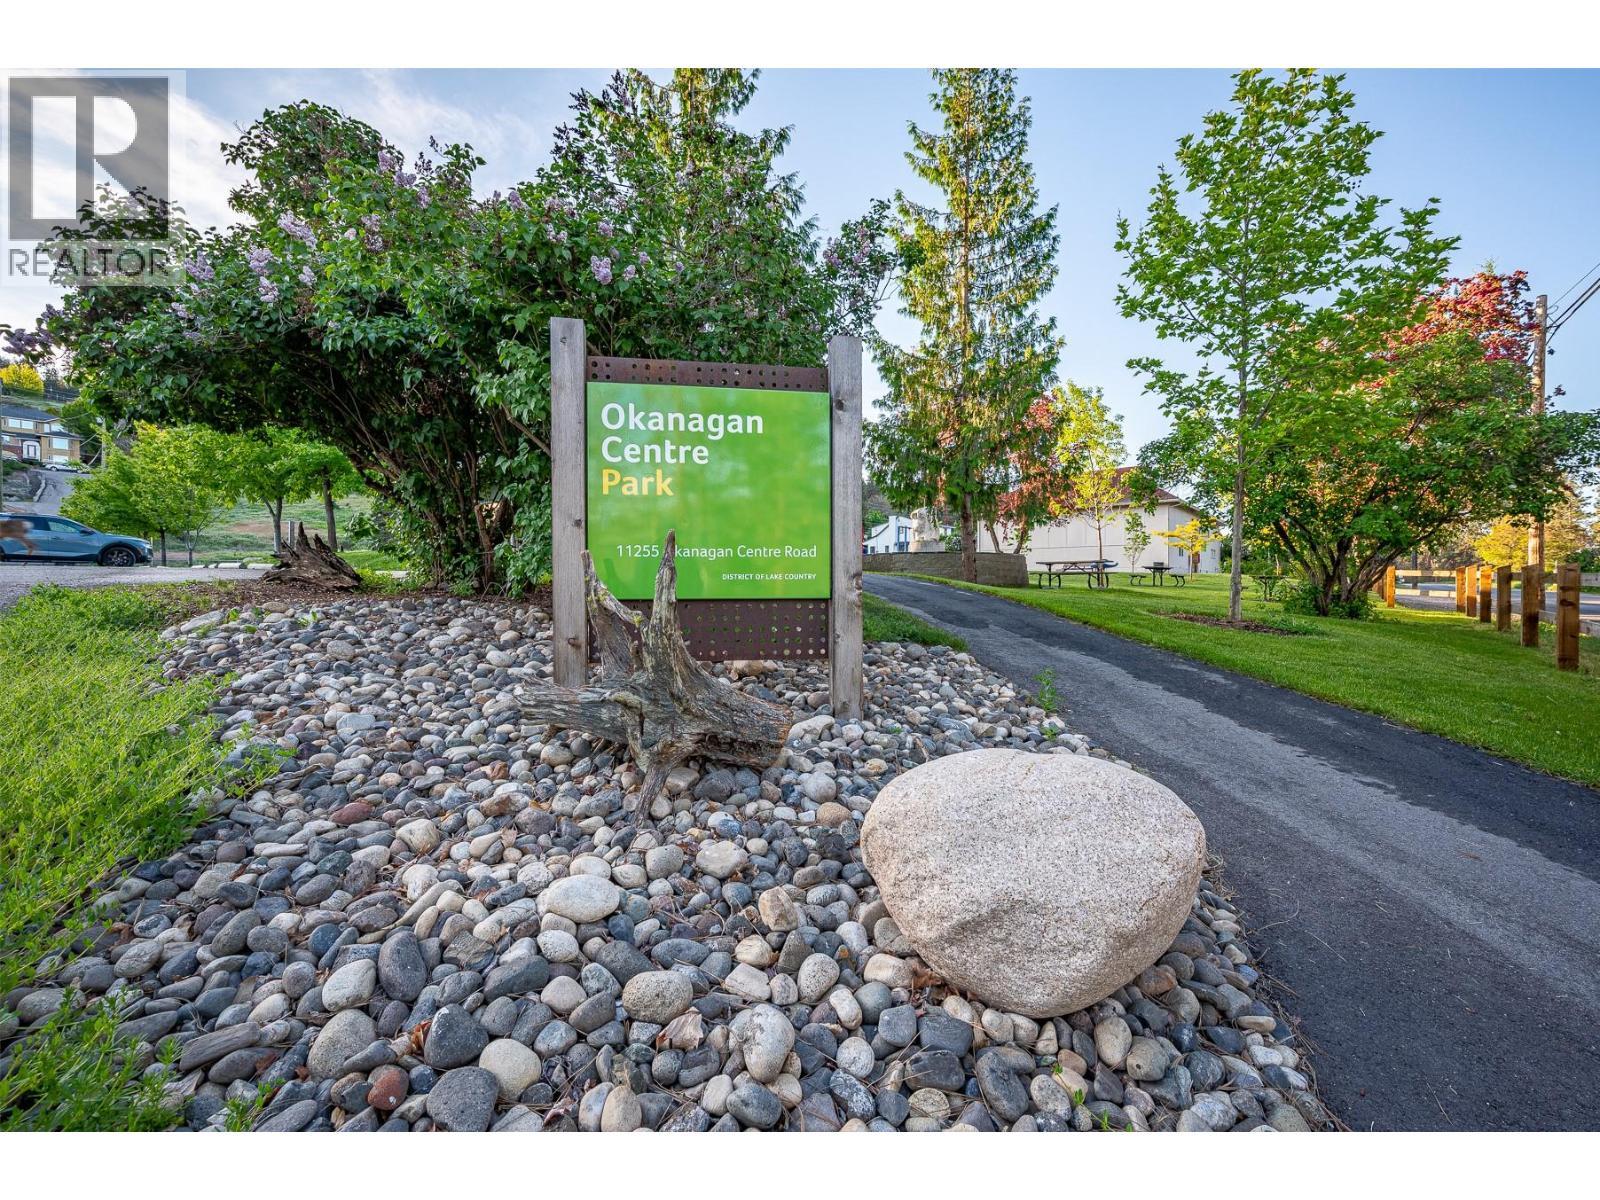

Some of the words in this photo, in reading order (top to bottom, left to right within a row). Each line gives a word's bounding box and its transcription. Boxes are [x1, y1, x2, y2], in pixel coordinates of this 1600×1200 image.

[601, 402, 764, 440] Okanagan
[601, 436, 710, 465] Centre
[602, 468, 674, 497] Park
[616, 544, 660, 558] 11255
[665, 544, 733, 560] kanagan
[737, 544, 781, 558] Centre
[784, 544, 817, 558] Road
[722, 573, 753, 581] DISTRICT
[755, 573, 764, 581] OF
[765, 573, 783, 581] LAKE
[784, 573, 817, 581] COUNTRY
